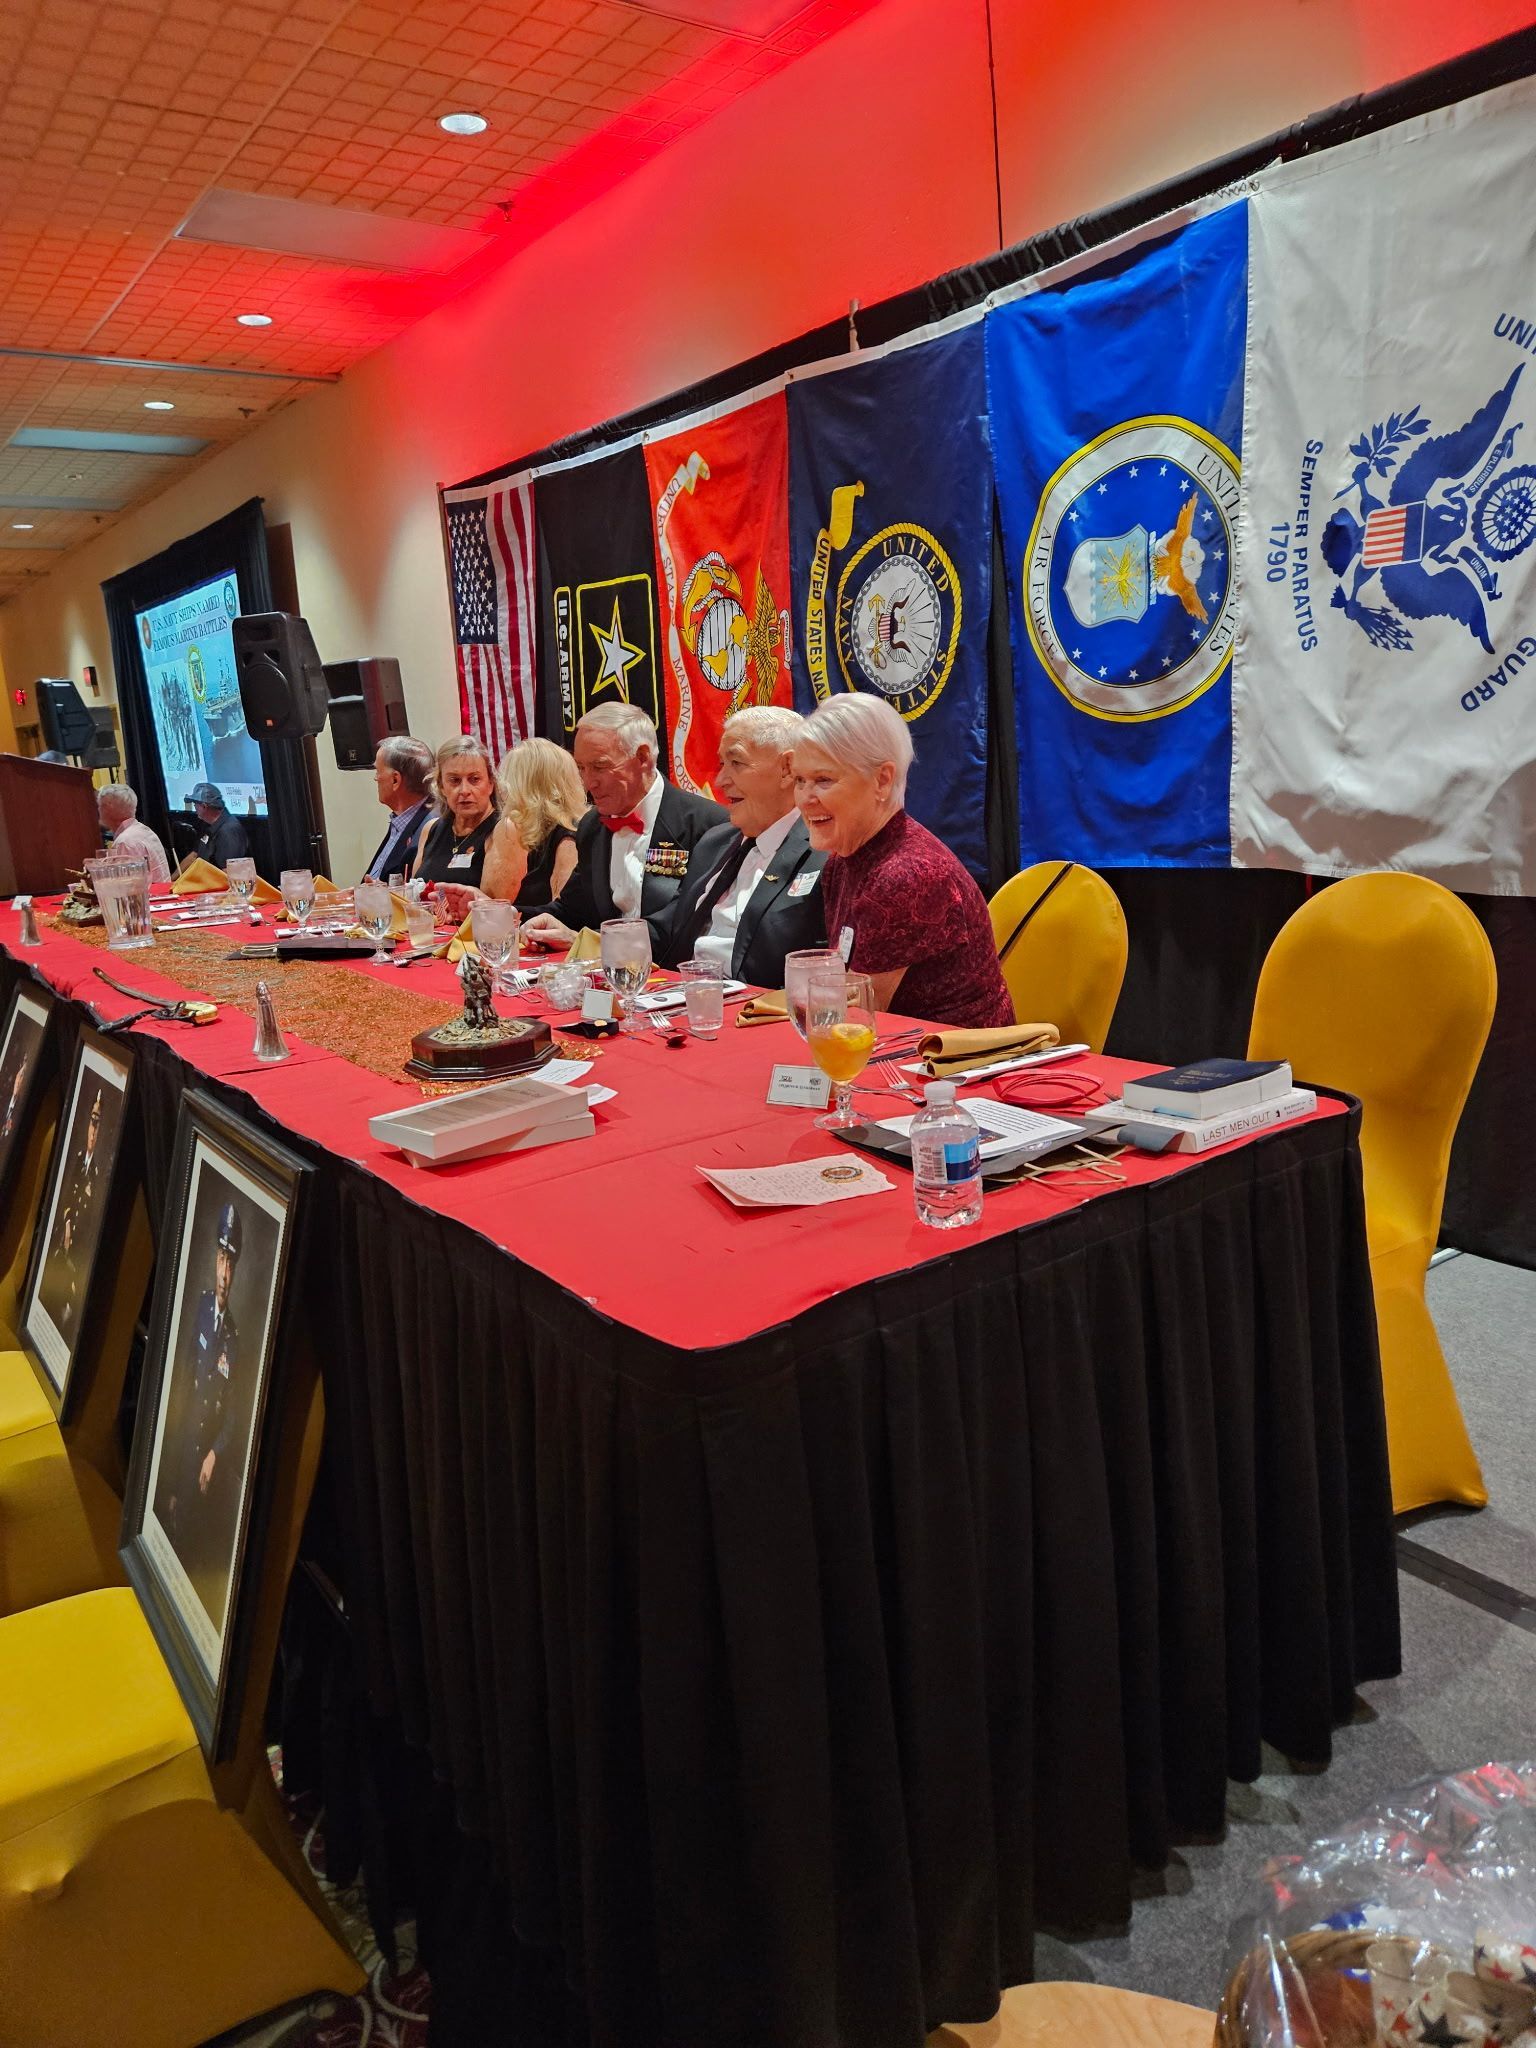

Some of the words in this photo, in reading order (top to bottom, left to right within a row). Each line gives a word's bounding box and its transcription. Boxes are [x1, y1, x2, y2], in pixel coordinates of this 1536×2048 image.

[1493, 313, 1536, 354] UNI
[1294, 439, 1324, 538] SEMPER
[1470, 455, 1499, 493] PLURIBUS
[811, 537, 830, 600] UNITED
[882, 536, 949, 592] UNITED
[1035, 526, 1052, 569] AIR
[1266, 522, 1291, 583] 1790
[1470, 557, 1488, 579] UNUM
[199, 616, 228, 637] BATTLES
[1032, 582, 1058, 661] FORCE
[1292, 547, 1319, 652] PARATUS
[809, 609, 823, 665] STATES
[839, 595, 855, 664] NAVY
[672, 656, 692, 733] MARINE
[812, 670, 828, 702] NAV
[1461, 637, 1536, 712] GUARD
[673, 755, 698, 795] CORPS
[1202, 1125, 1229, 1142] LAST
[1229, 1119, 1250, 1133] MEN
[1251, 1111, 1271, 1125] OUT
